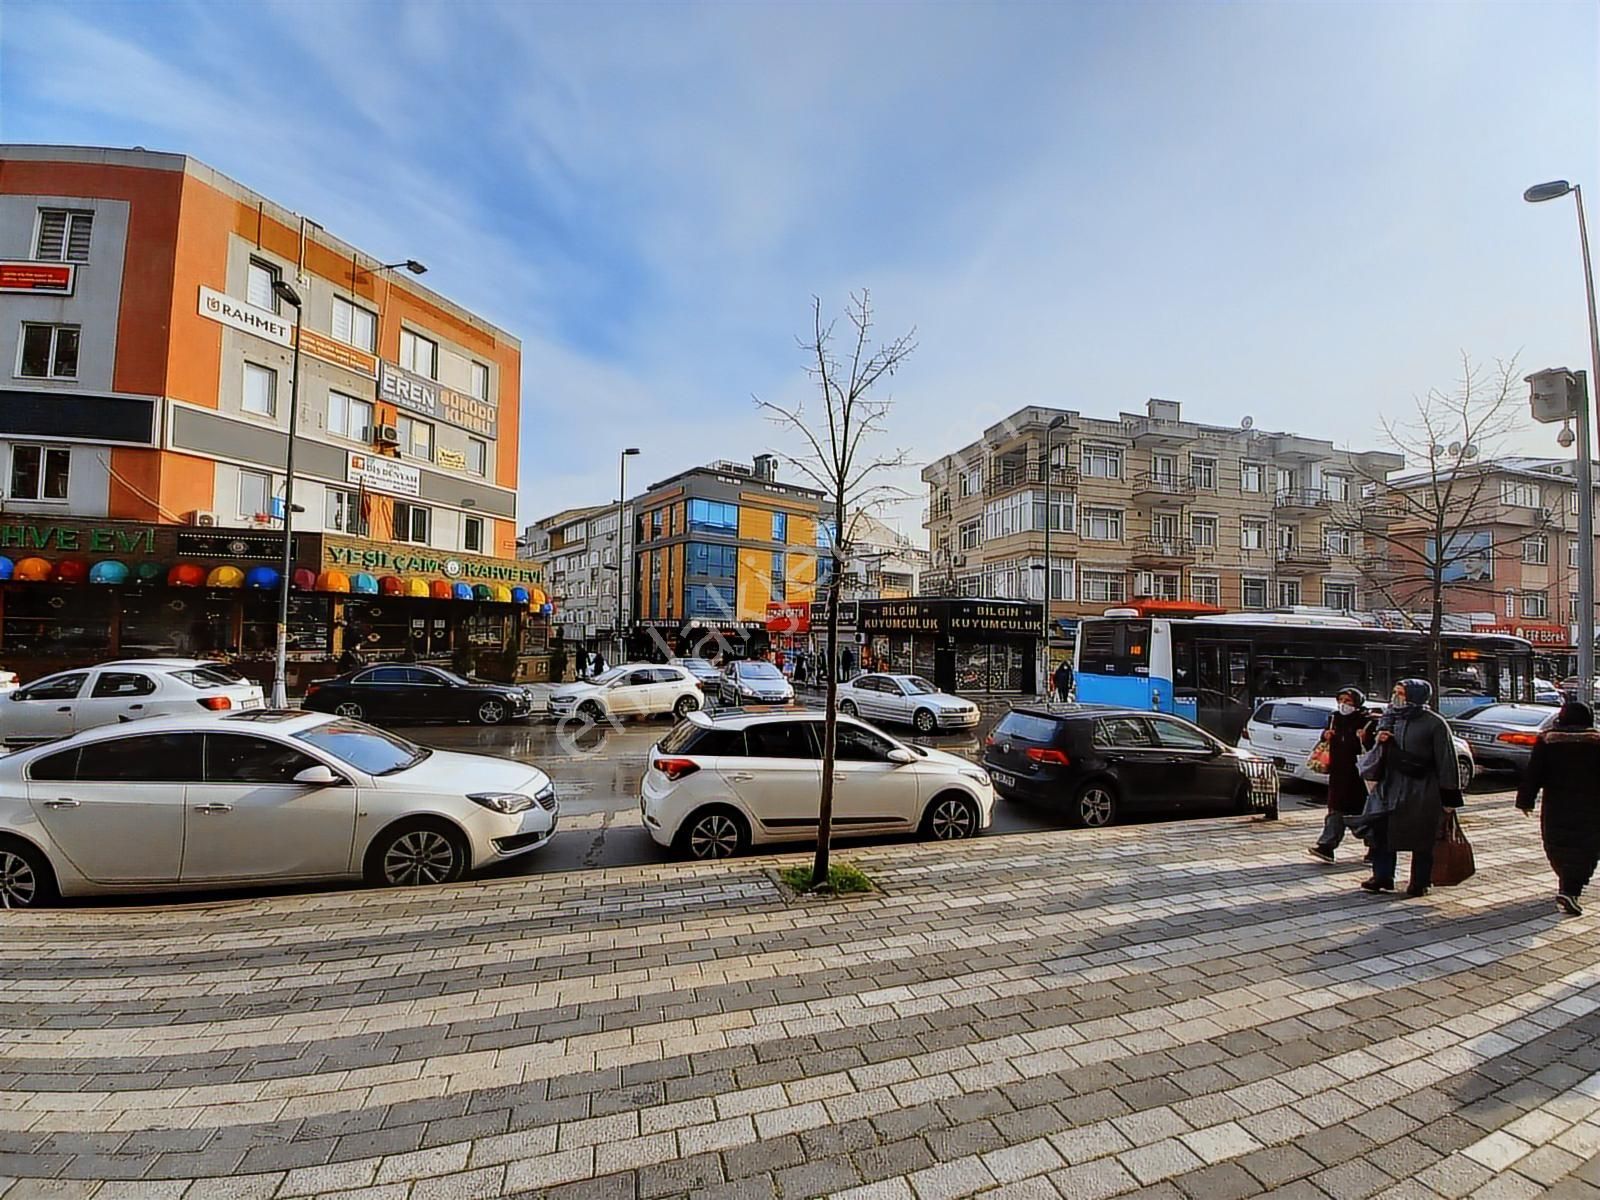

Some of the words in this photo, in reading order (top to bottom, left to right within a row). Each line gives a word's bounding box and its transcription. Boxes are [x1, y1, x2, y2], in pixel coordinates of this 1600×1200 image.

[222, 303, 287, 337] RAHMET
[383, 373, 436, 409] EREN
[881, 602, 918, 617] BİLGİN
[976, 603, 1019, 617] BİLGİN
[864, 618, 939, 630] KUYUMCULUK
[951, 618, 1042, 631] KUYUMCULUK
